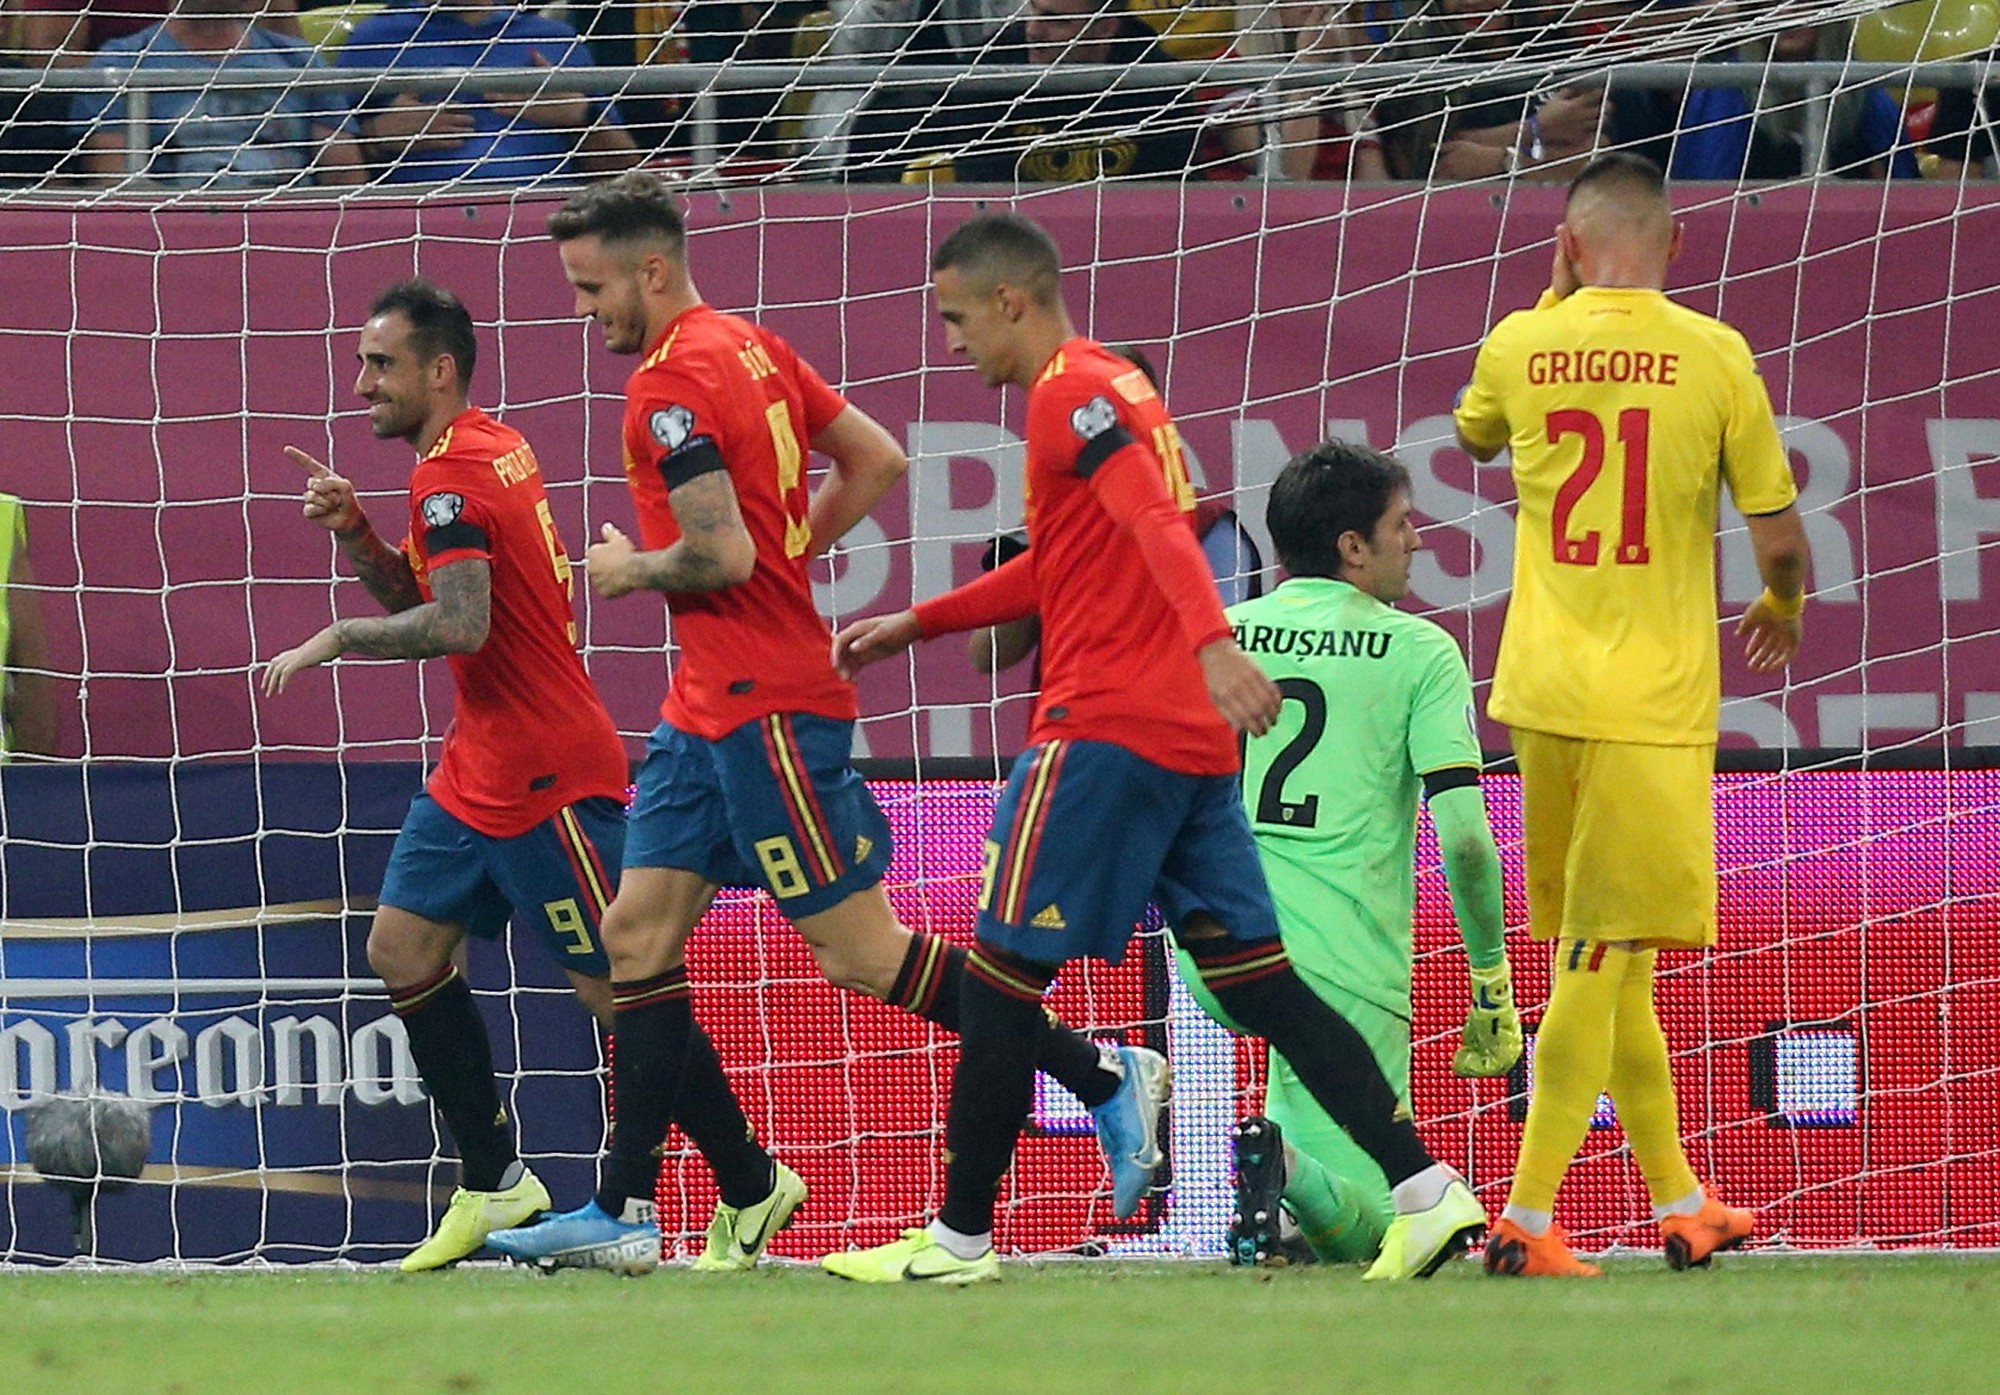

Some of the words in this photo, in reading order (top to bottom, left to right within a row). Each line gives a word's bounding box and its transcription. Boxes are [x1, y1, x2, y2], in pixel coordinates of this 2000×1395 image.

[1528, 350, 1679, 385] GRIGORE
[1546, 408, 1650, 565] 21
[1233, 618, 1392, 662] ĂRUȘANU
[1241, 677, 1327, 828] 2
[754, 835, 810, 899] 8
[543, 898, 595, 955] 9
